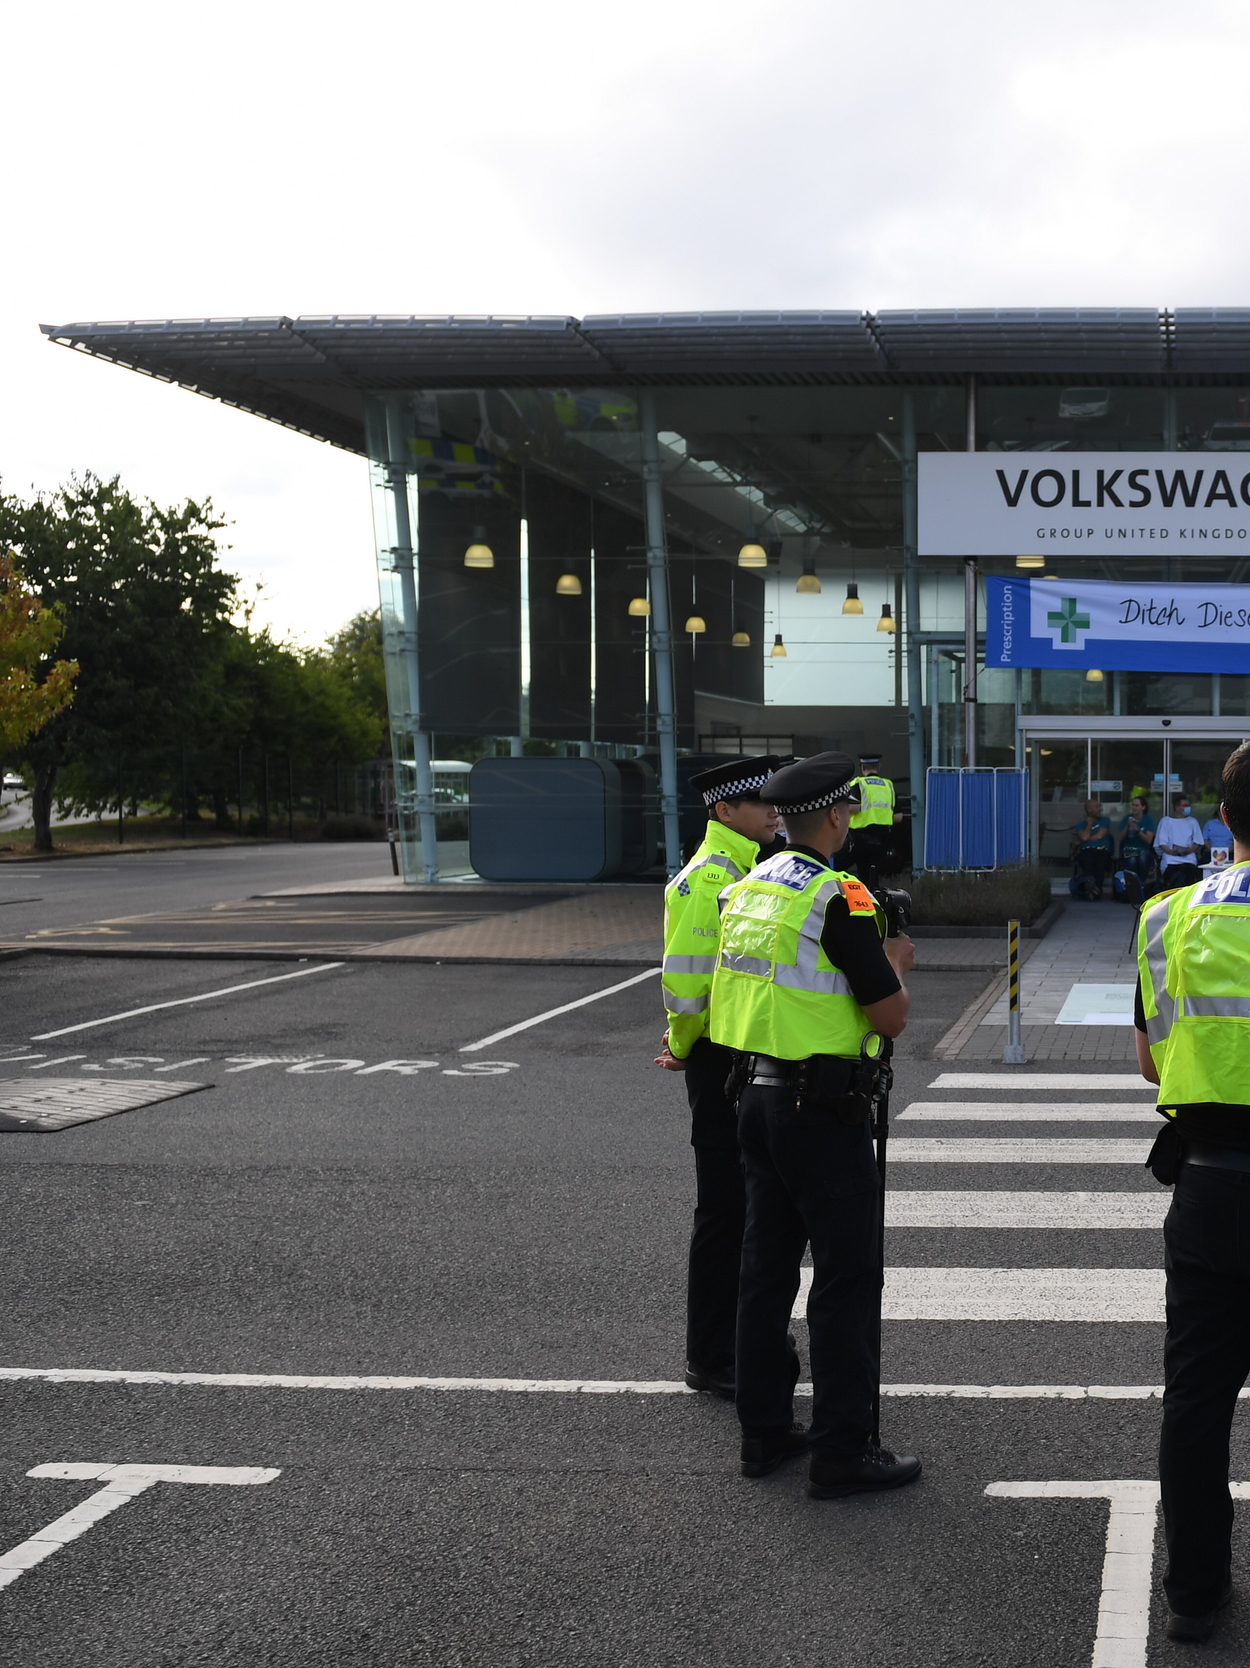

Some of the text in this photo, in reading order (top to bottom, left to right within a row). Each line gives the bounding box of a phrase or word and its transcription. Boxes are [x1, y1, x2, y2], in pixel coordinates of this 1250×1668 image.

[1036, 528, 1095, 539] GROUP
[1105, 528, 1170, 539] UNITED
[1118, 598, 1186, 626] Ditch
[1000, 585, 1015, 662] Prescription
[692, 926, 718, 938] POLICE
